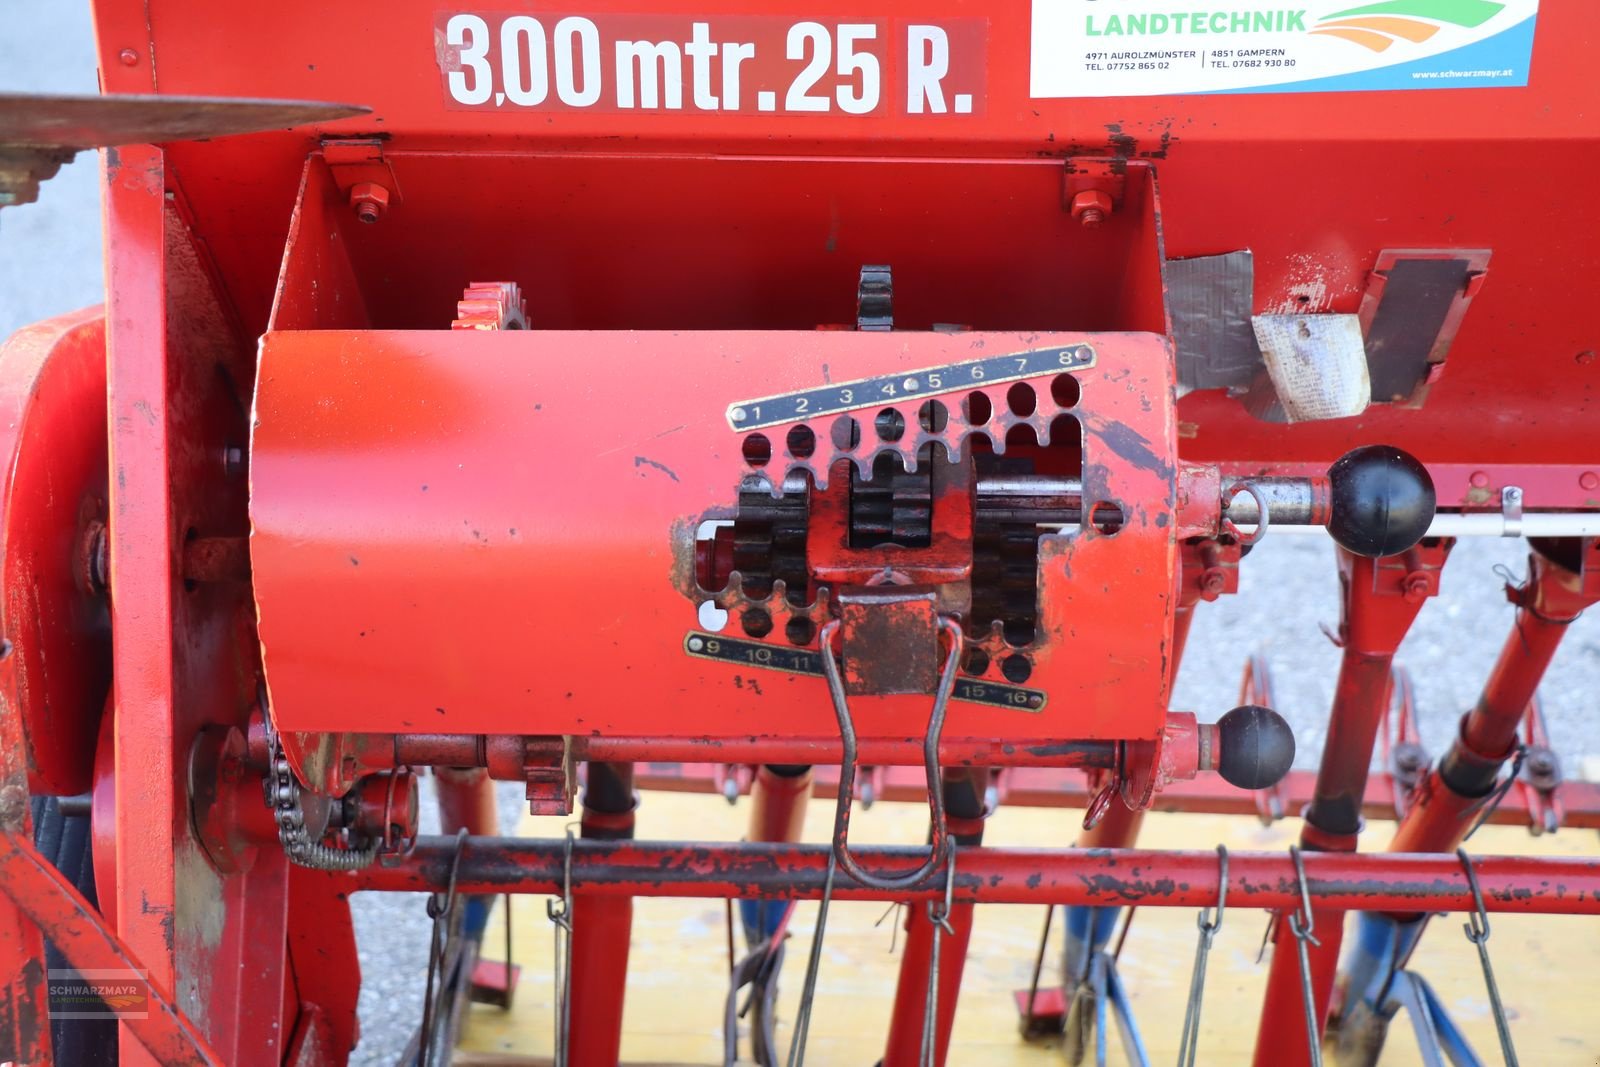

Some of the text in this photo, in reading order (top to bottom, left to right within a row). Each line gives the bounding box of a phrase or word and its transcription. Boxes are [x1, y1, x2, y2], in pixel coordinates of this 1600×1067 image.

[1085, 10, 1307, 37] LANDTECHNIK
[1085, 49, 1196, 60] 4971 AUROLZMÜNSTER
[1211, 48, 1286, 58] 4851 GAMPERN
[447, 14, 601, 108] 3,00
[906, 24, 973, 114] R.
[1085, 61, 1170, 71] TEL. 07752 865 02
[1211, 58, 1296, 68] TEL. 07682 930 80
[1412, 68, 1513, 79] www.schwarzmayr.at
[752, 351, 1073, 420] 1 2 3 4 5 6 7 8
[706, 640, 1028, 704] 9 10 11 15 16
